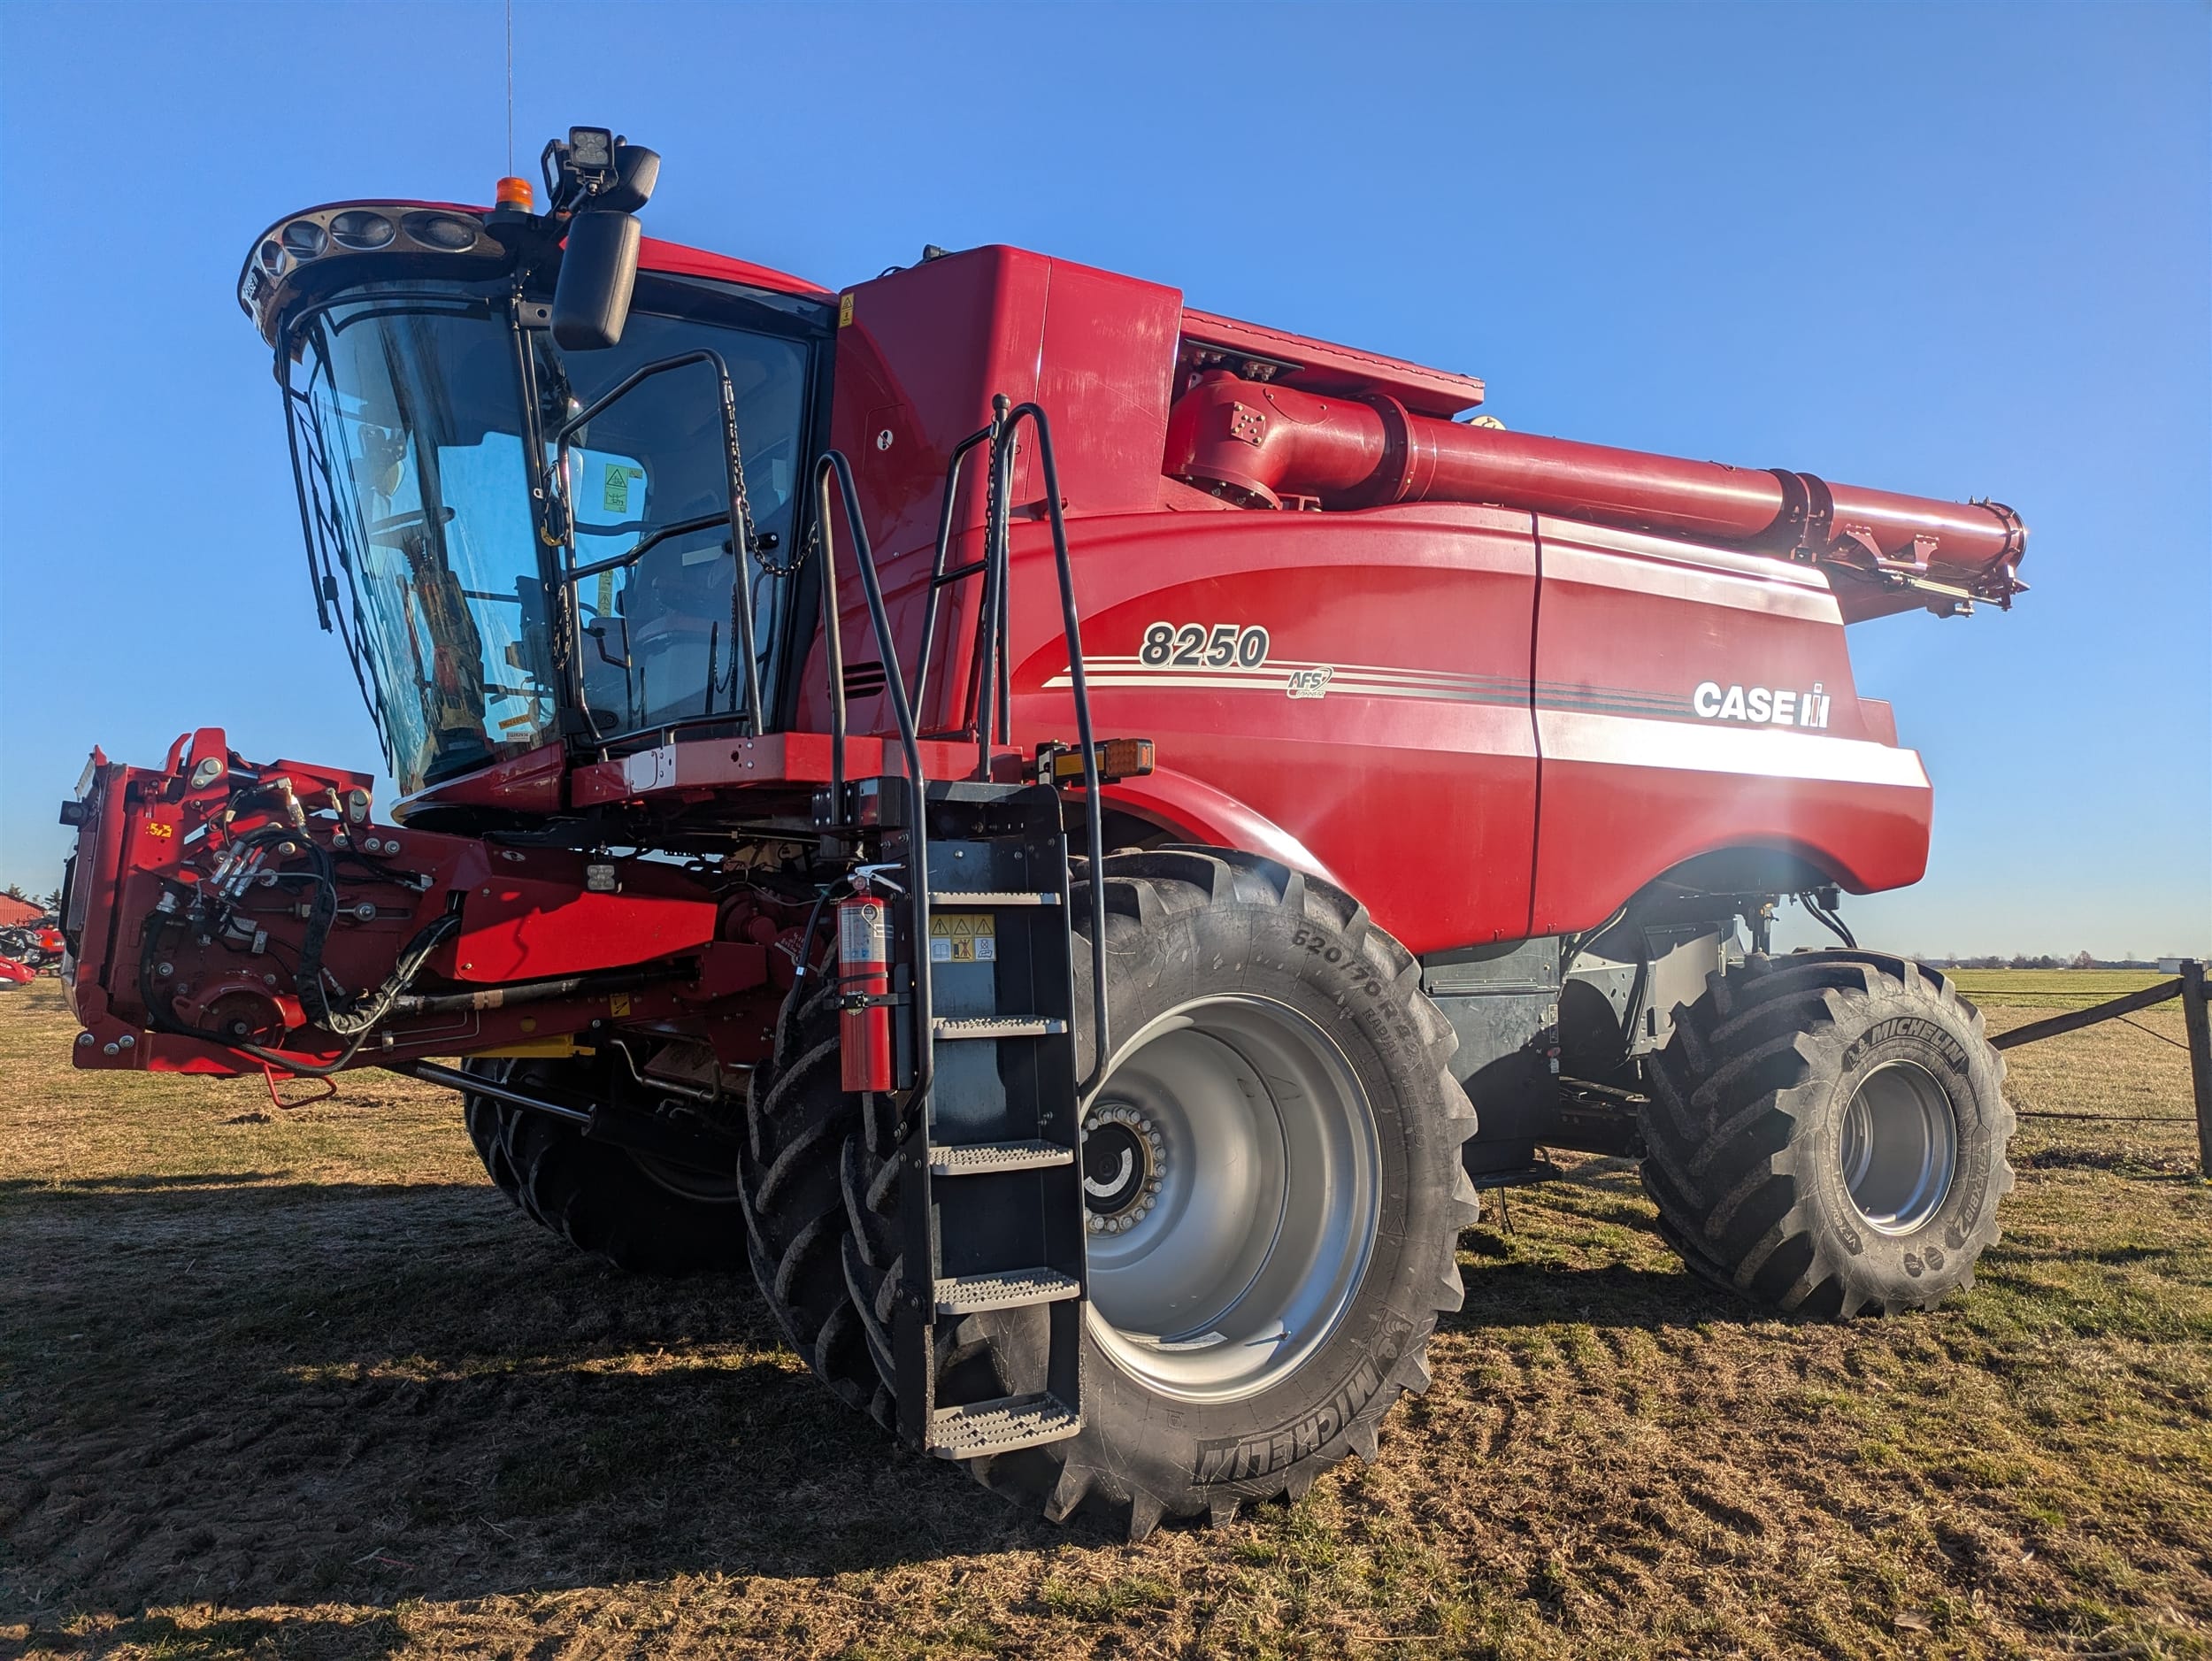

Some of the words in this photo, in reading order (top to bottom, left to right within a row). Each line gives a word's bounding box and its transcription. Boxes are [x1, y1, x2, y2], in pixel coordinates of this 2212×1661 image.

[1140, 622, 1269, 670] 8250
[1288, 672, 1324, 688] AFS
[1694, 681, 1796, 726] CASE
[1363, 1008, 1399, 1058] RADIAL
[1871, 1019, 1966, 1061] MICHELIN
[1201, 1359, 1379, 1483] MICHELIN
